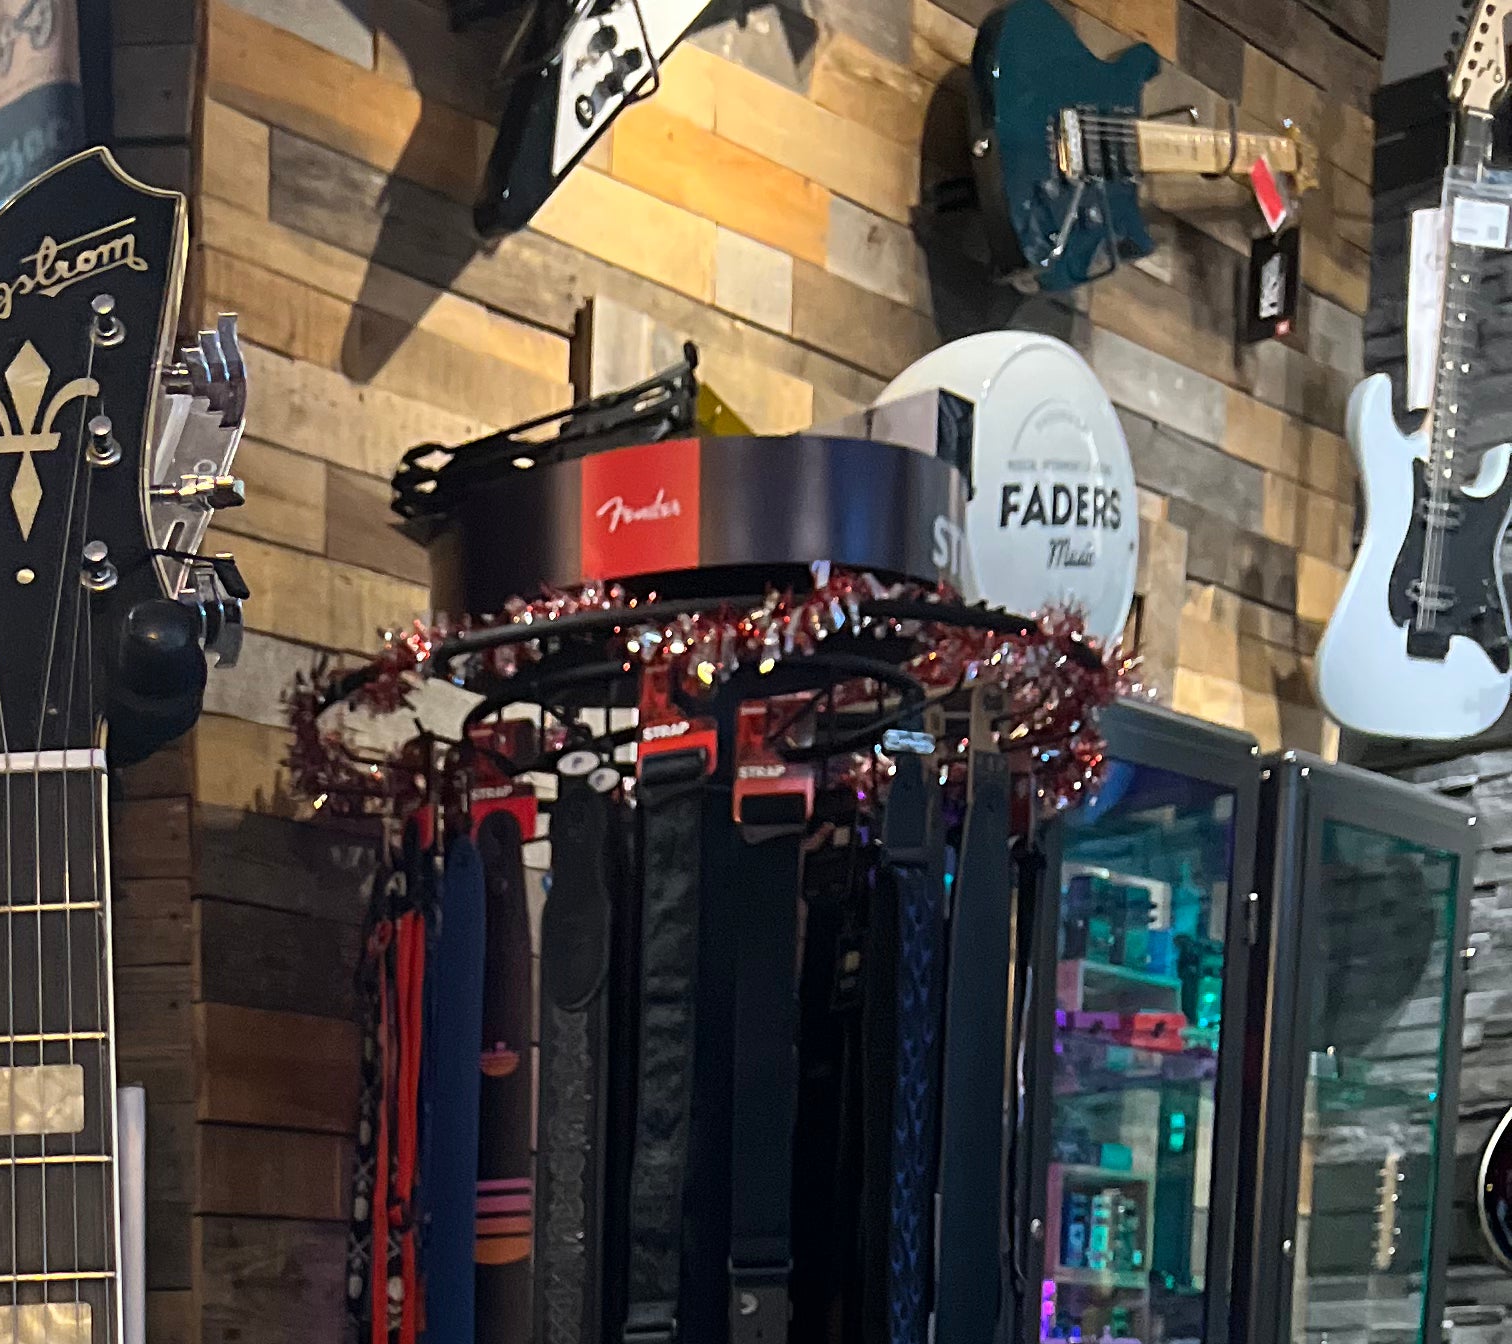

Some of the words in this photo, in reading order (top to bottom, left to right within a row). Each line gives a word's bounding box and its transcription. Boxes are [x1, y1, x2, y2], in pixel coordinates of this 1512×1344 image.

[596, 488, 680, 533] Fender
[1000, 483, 1122, 530] FADERS
[642, 720, 690, 741] STRAP
[738, 764, 786, 779] STRAP
